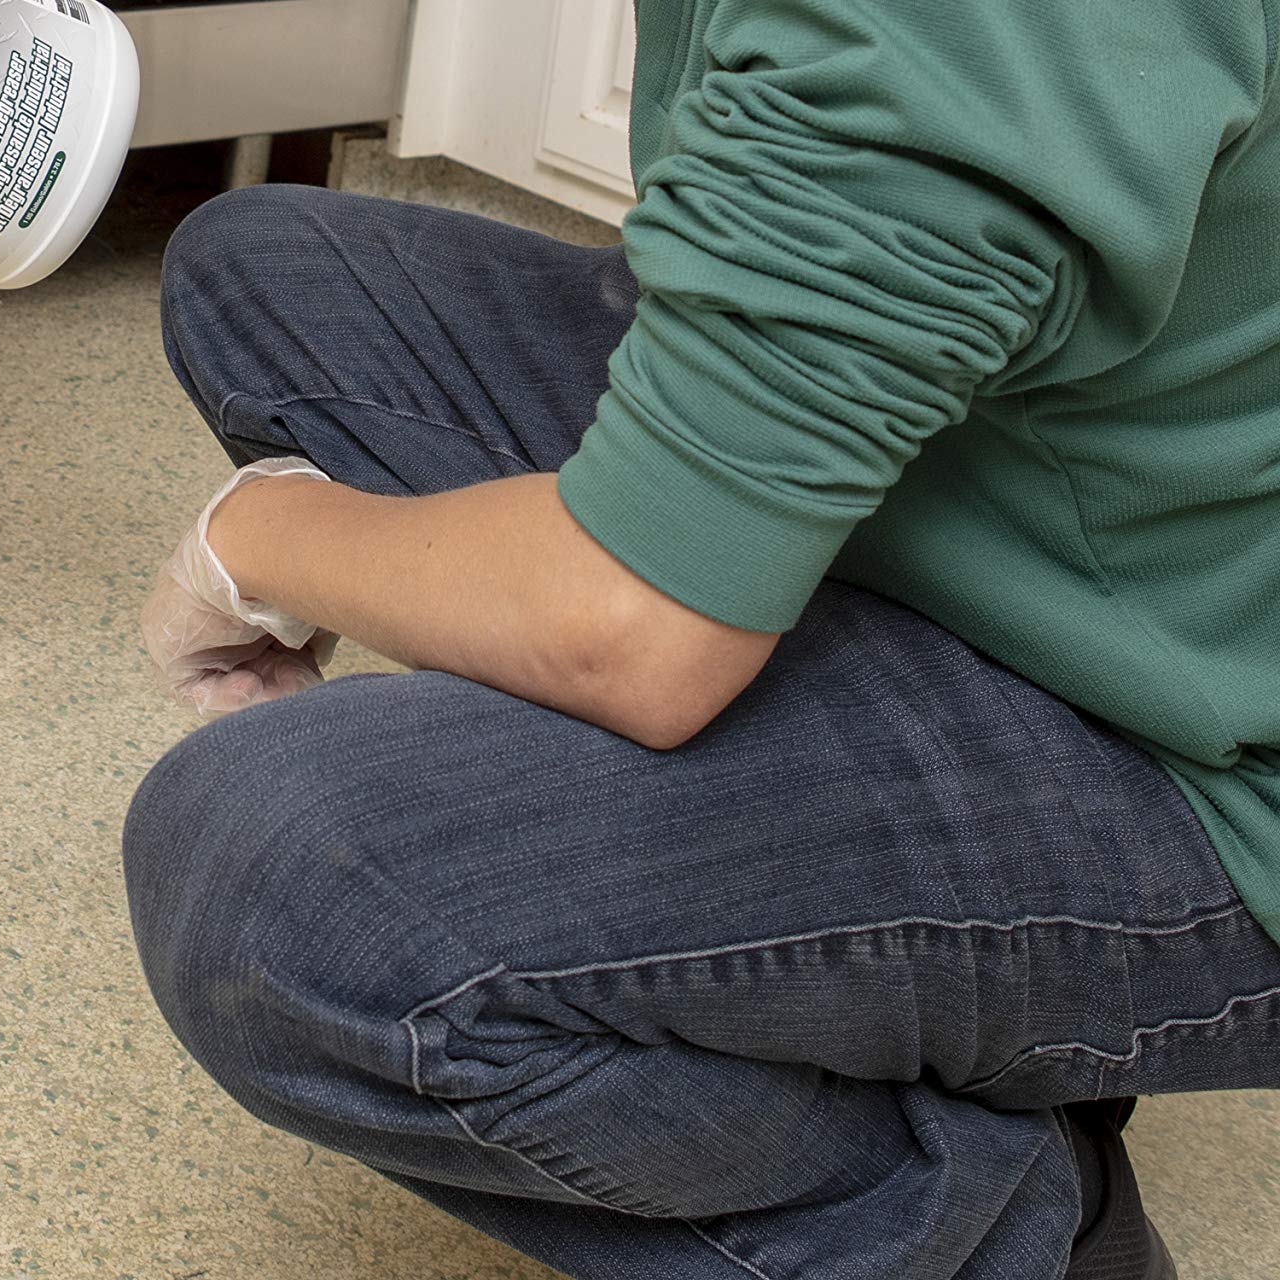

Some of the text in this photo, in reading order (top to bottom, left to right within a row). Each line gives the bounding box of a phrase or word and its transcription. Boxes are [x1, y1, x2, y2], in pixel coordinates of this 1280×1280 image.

[19, 37, 52, 118] Industrial
[39, 52, 73, 134] Industriel
[51, 162, 61, 176] 3.78
